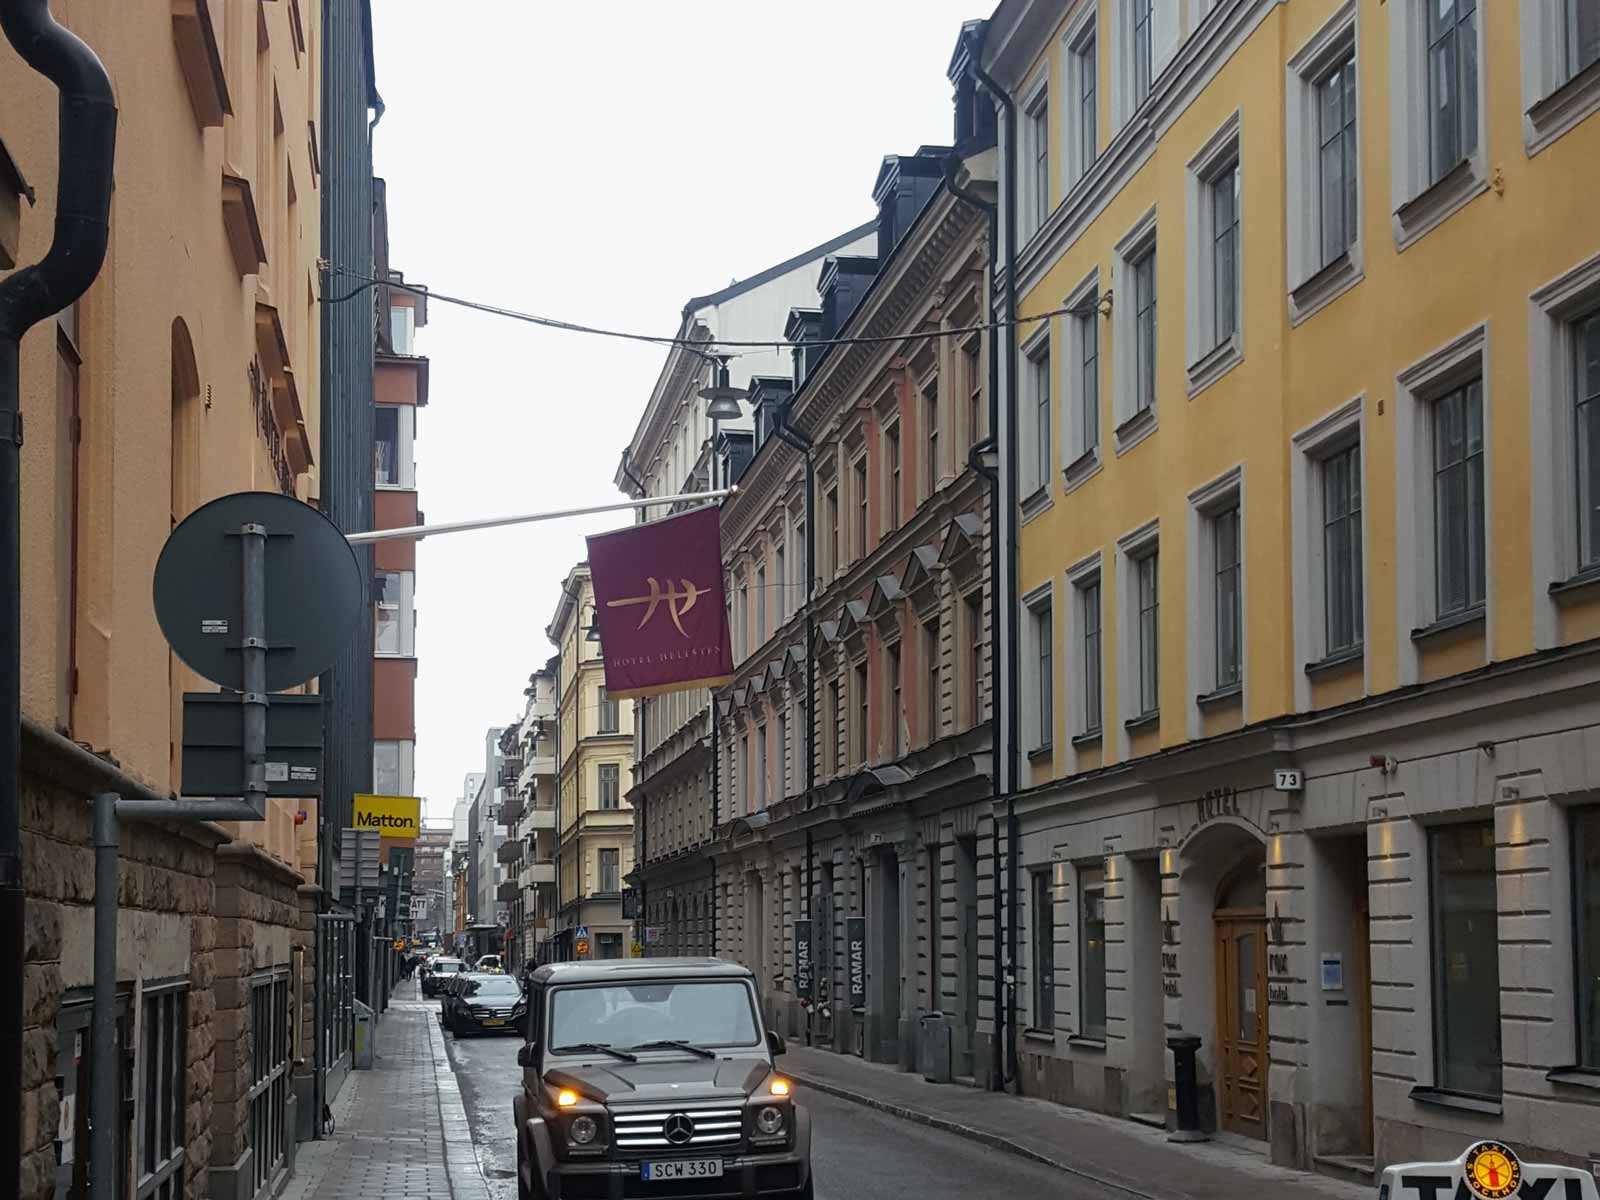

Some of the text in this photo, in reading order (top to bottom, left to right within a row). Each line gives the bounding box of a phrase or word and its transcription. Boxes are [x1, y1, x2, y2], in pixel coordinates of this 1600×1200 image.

[613, 655, 651, 668] HOTEL
[1279, 774, 1297, 787] 73
[1197, 787, 1240, 824] HOTEL
[356, 811, 413, 828] Matton
[798, 940, 809, 989] RAMAR
[851, 940, 863, 995] RAMAR
[1472, 1144, 1508, 1155] TAXI
[655, 1161, 717, 1178] SCW 330
[1466, 1160, 1520, 1198] STOCKHOLM
